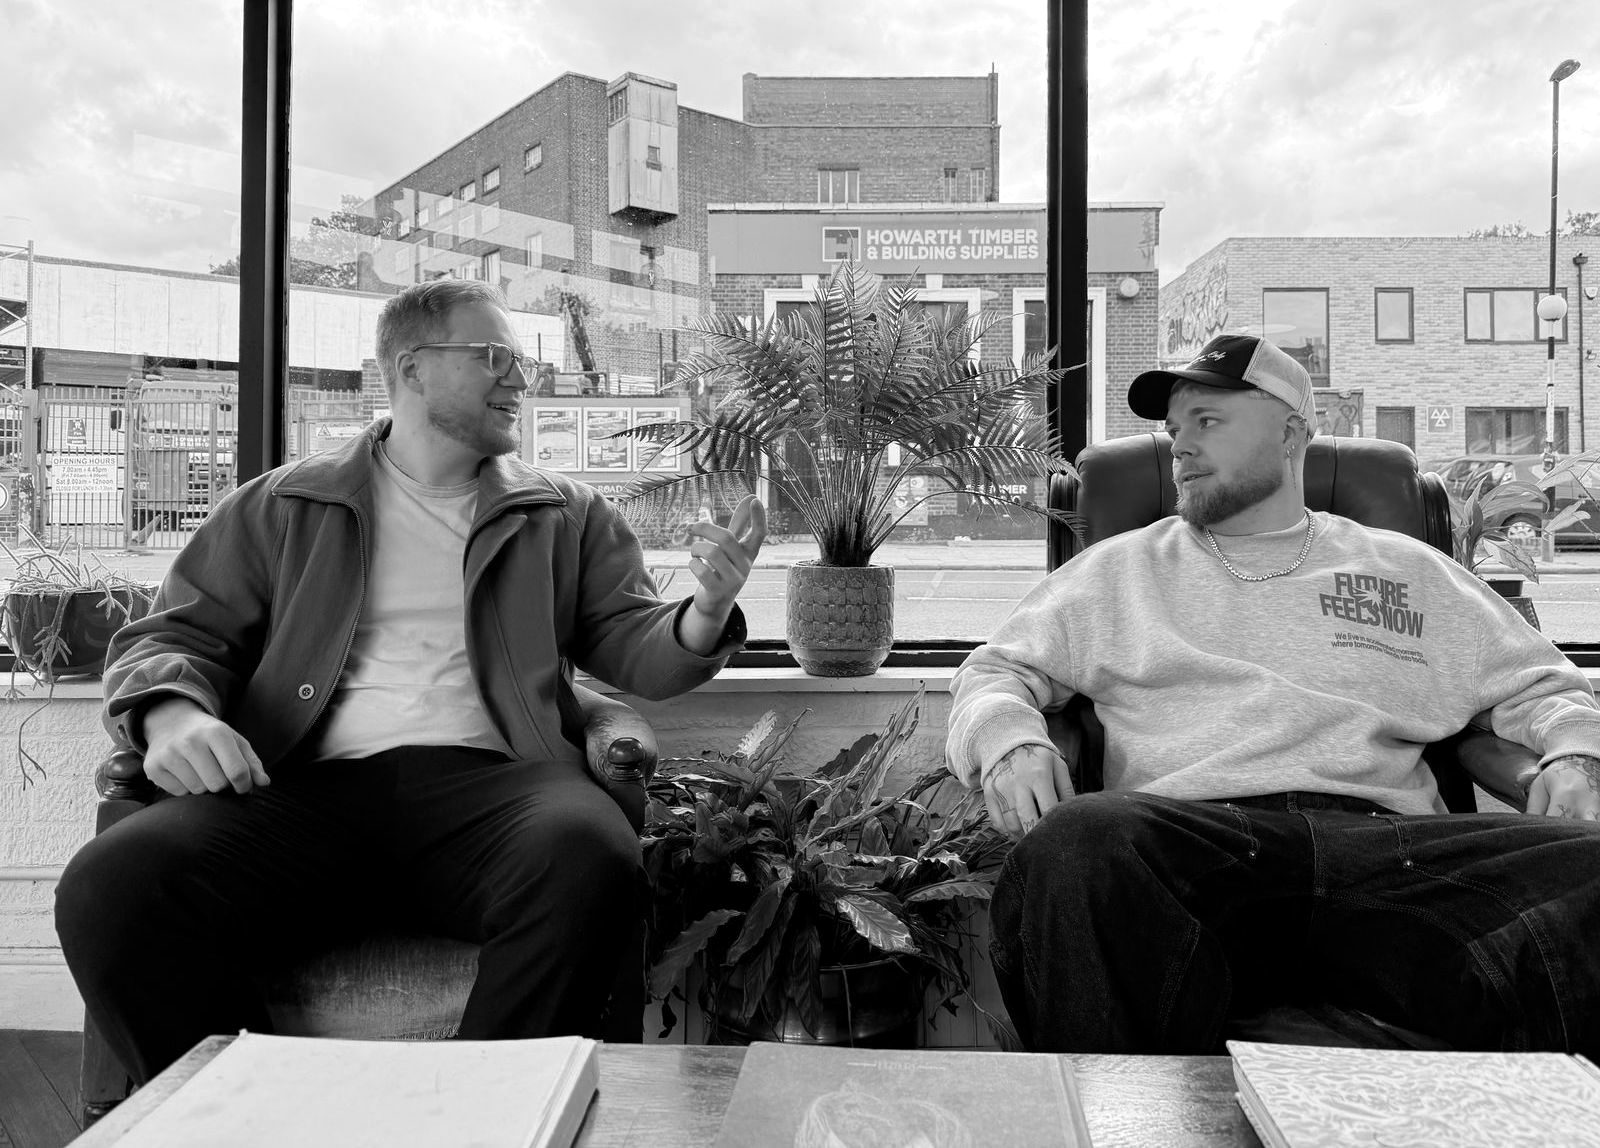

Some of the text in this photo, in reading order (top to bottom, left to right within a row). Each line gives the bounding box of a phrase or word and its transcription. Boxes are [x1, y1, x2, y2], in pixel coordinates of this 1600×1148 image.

[866, 228, 1039, 246] HOWARTH TIMBER
[866, 245, 1040, 260] & BUILDING SUPPLIES
[598, 485, 623, 494] ROAD
[1334, 572, 1409, 609] FUTURE
[1319, 593, 1424, 639] FEELS NOW
[1334, 632, 1347, 640] We
[1347, 632, 1359, 640] live
[1331, 640, 1354, 649] where
[1354, 641, 1383, 653] tomorrow
